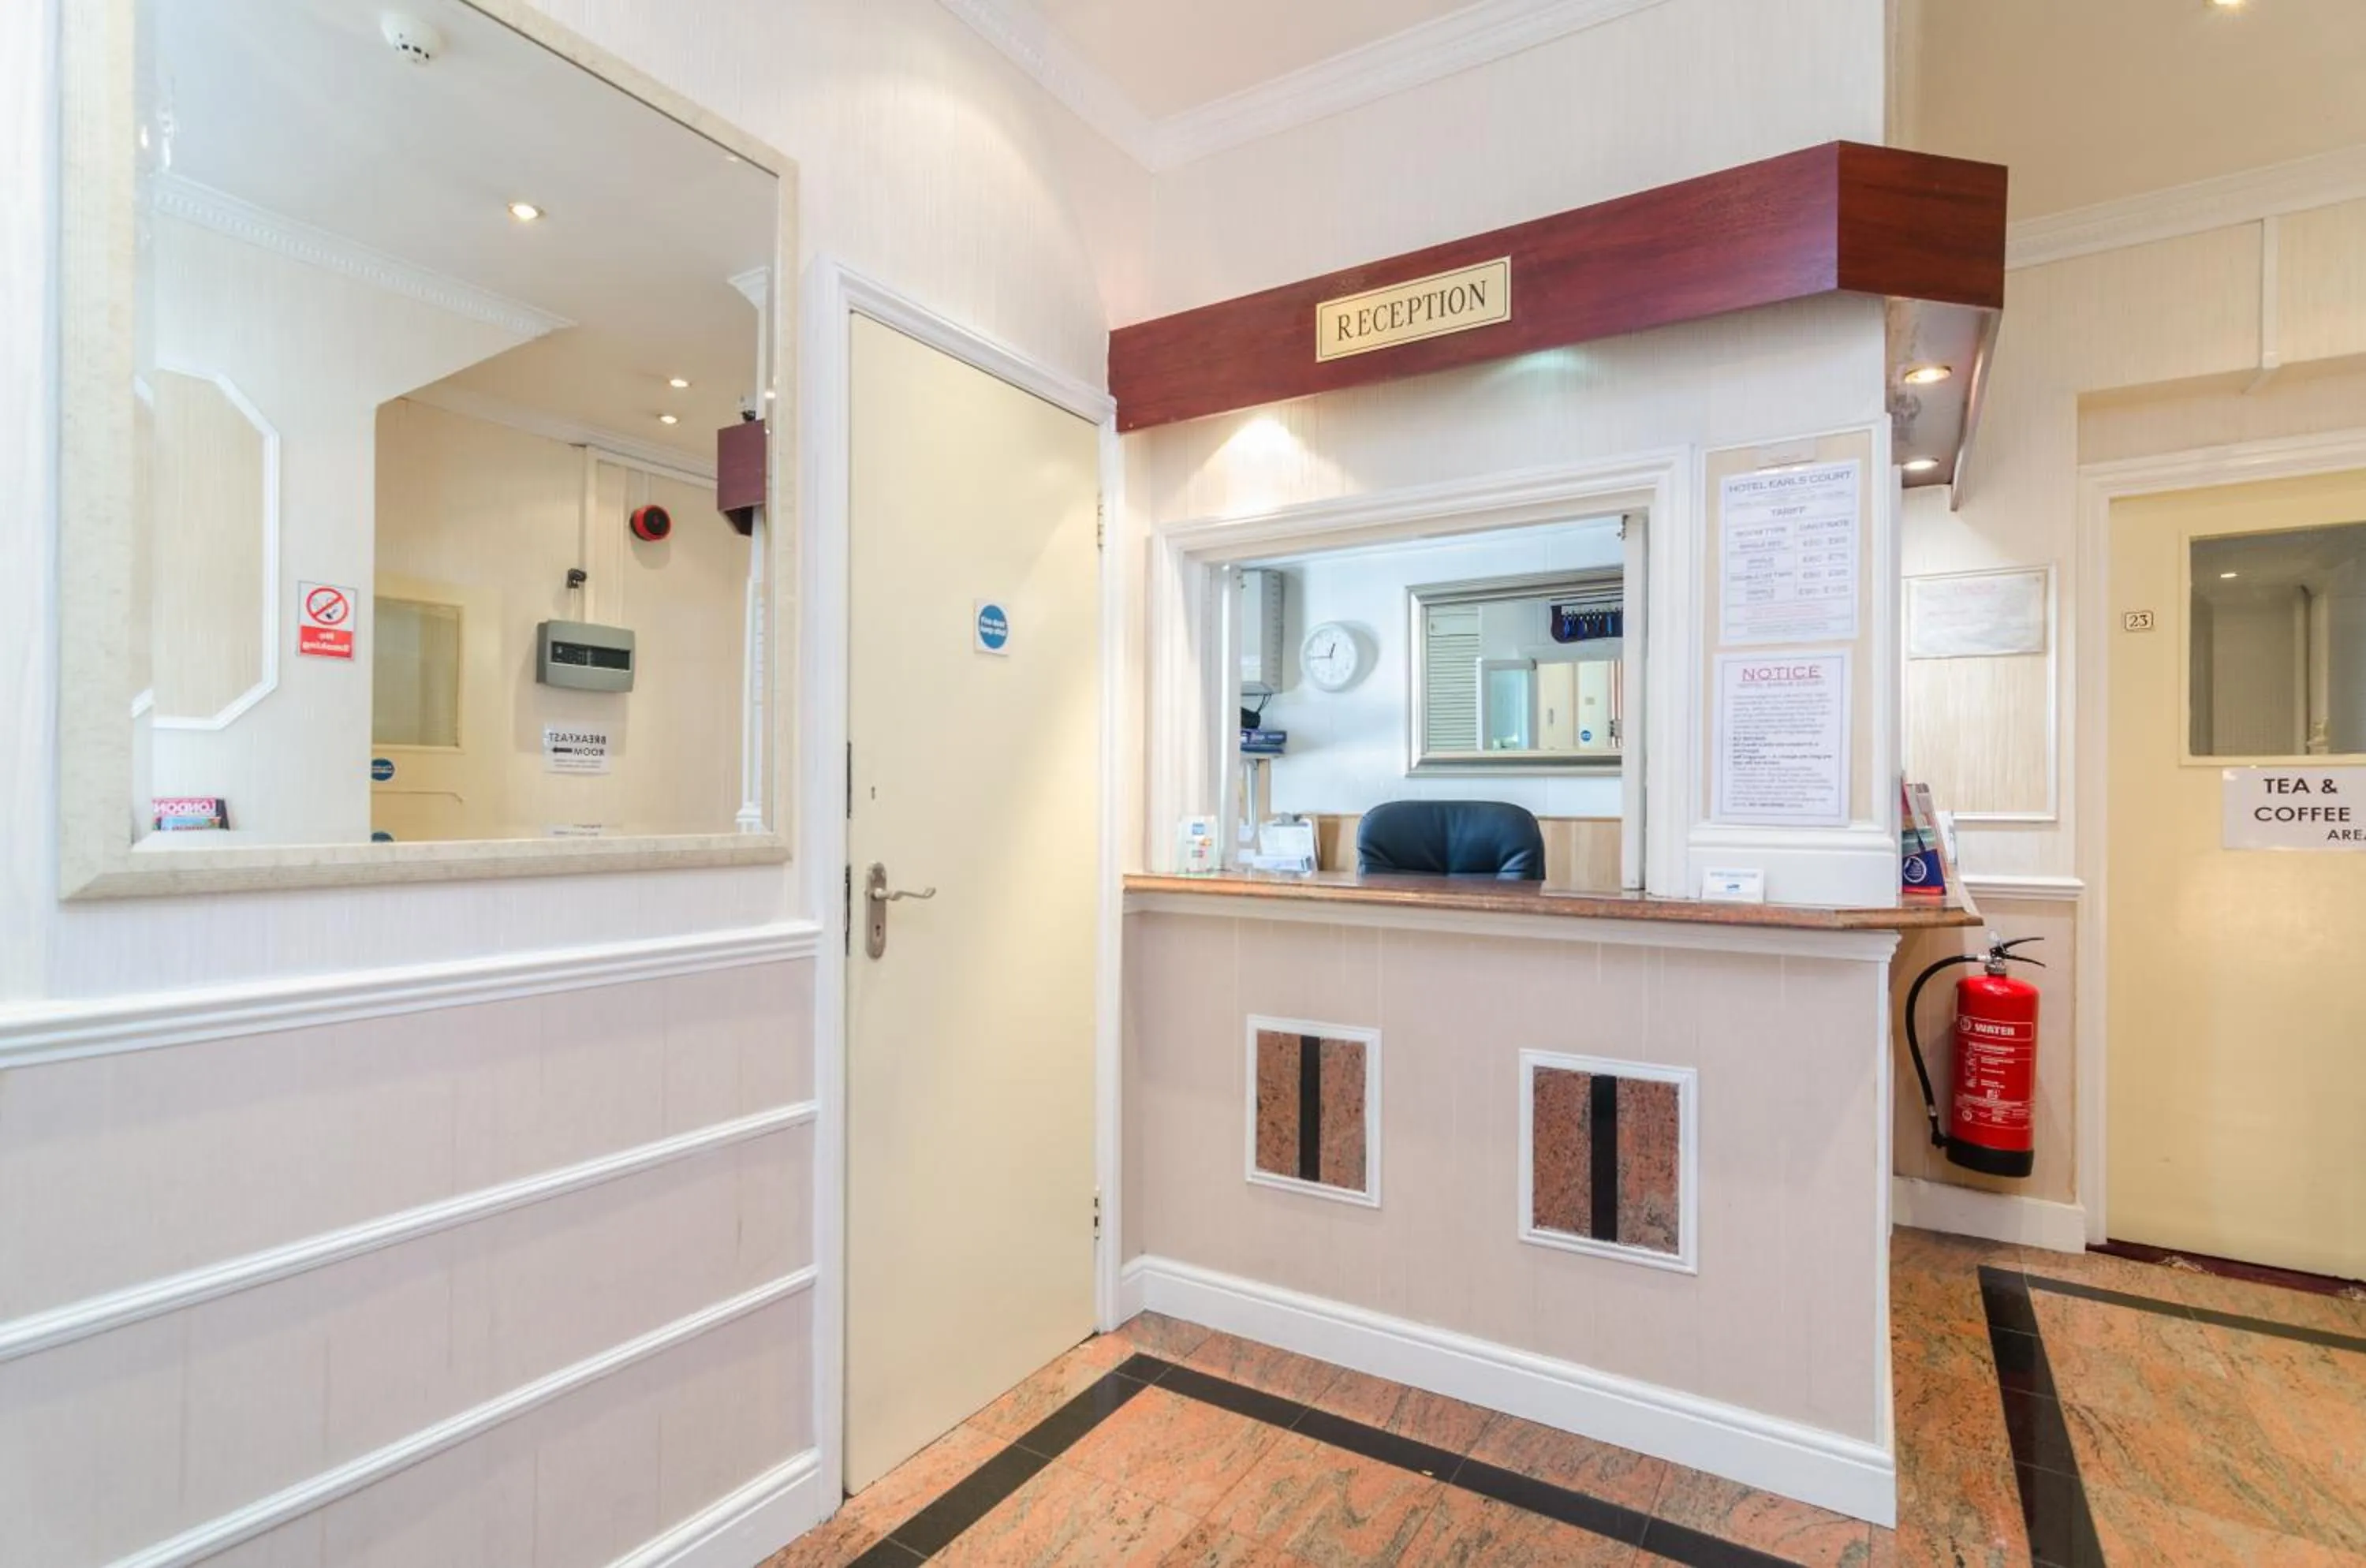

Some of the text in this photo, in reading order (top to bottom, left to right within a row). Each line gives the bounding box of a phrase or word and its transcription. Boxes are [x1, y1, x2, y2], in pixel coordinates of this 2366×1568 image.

[1337, 280, 1487, 342] RECEPTION
[1729, 470, 1853, 493] HOTEL EARLS COURT
[2129, 614, 2148, 628] 23
[1741, 665, 1823, 682] NOTICE
[2263, 778, 2338, 794] TEA &
[2254, 807, 2351, 822] COFFEE
[1974, 1023, 2015, 1036] WATER
